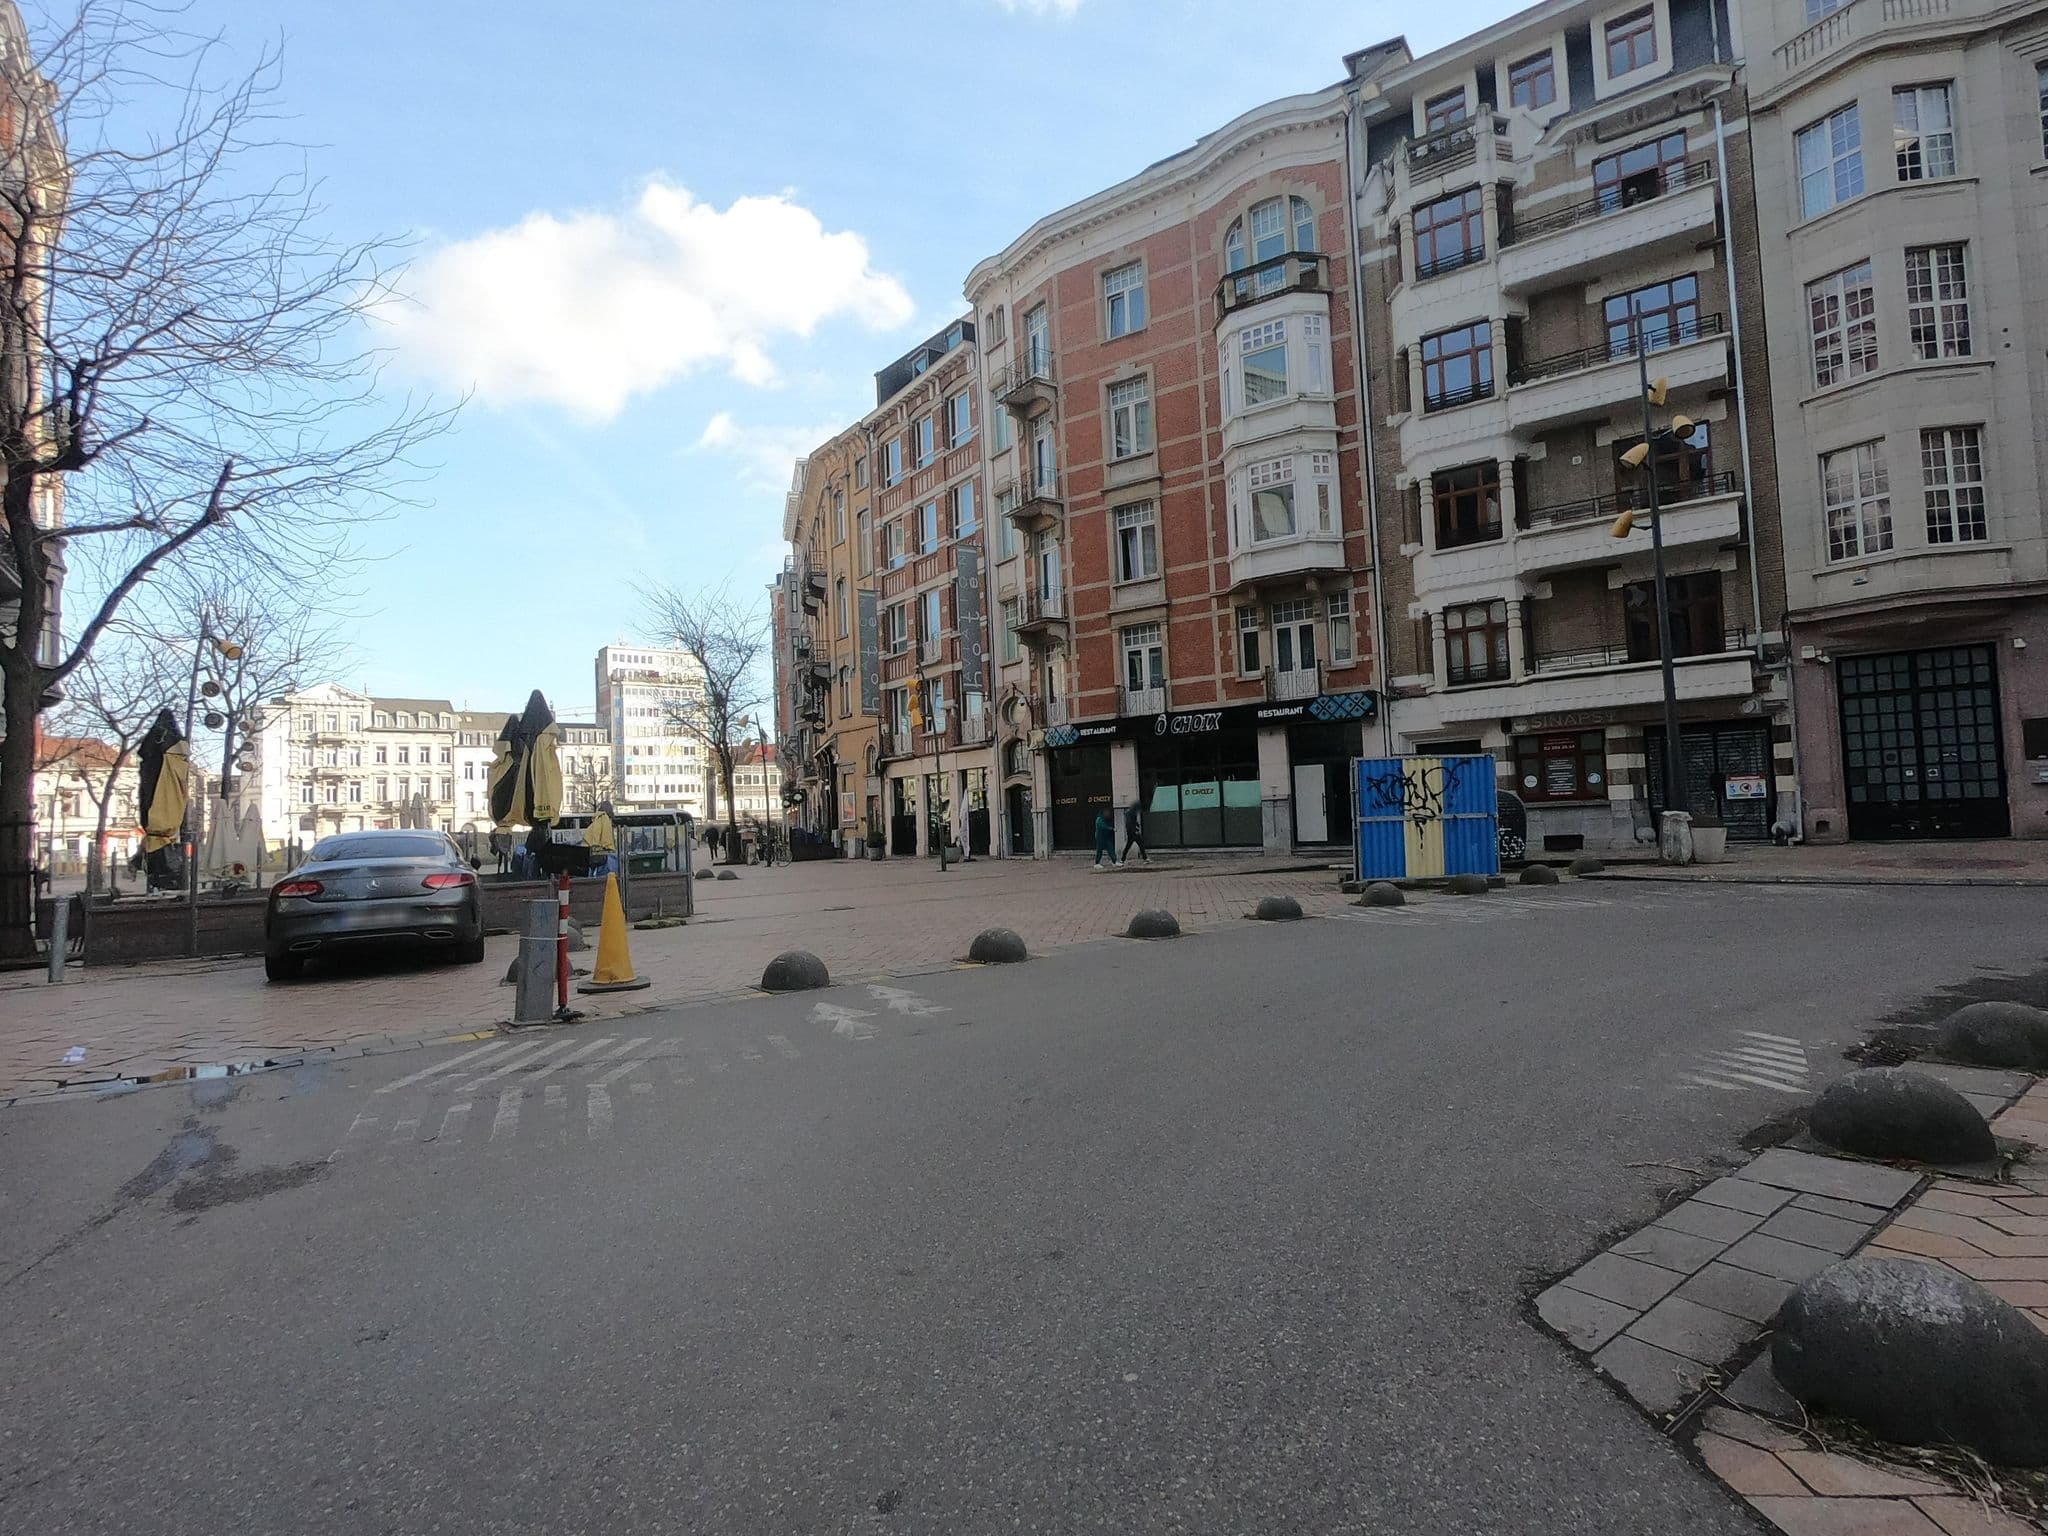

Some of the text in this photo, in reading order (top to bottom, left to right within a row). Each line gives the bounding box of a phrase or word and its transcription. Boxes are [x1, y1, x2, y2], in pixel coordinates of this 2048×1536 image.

[957, 548, 984, 688] hotel
[858, 592, 880, 712] hotel
[1170, 712, 1222, 734] CHOIX
[1257, 706, 1304, 719] RESTAURANT
[1080, 725, 1117, 736] RESTAURANT
